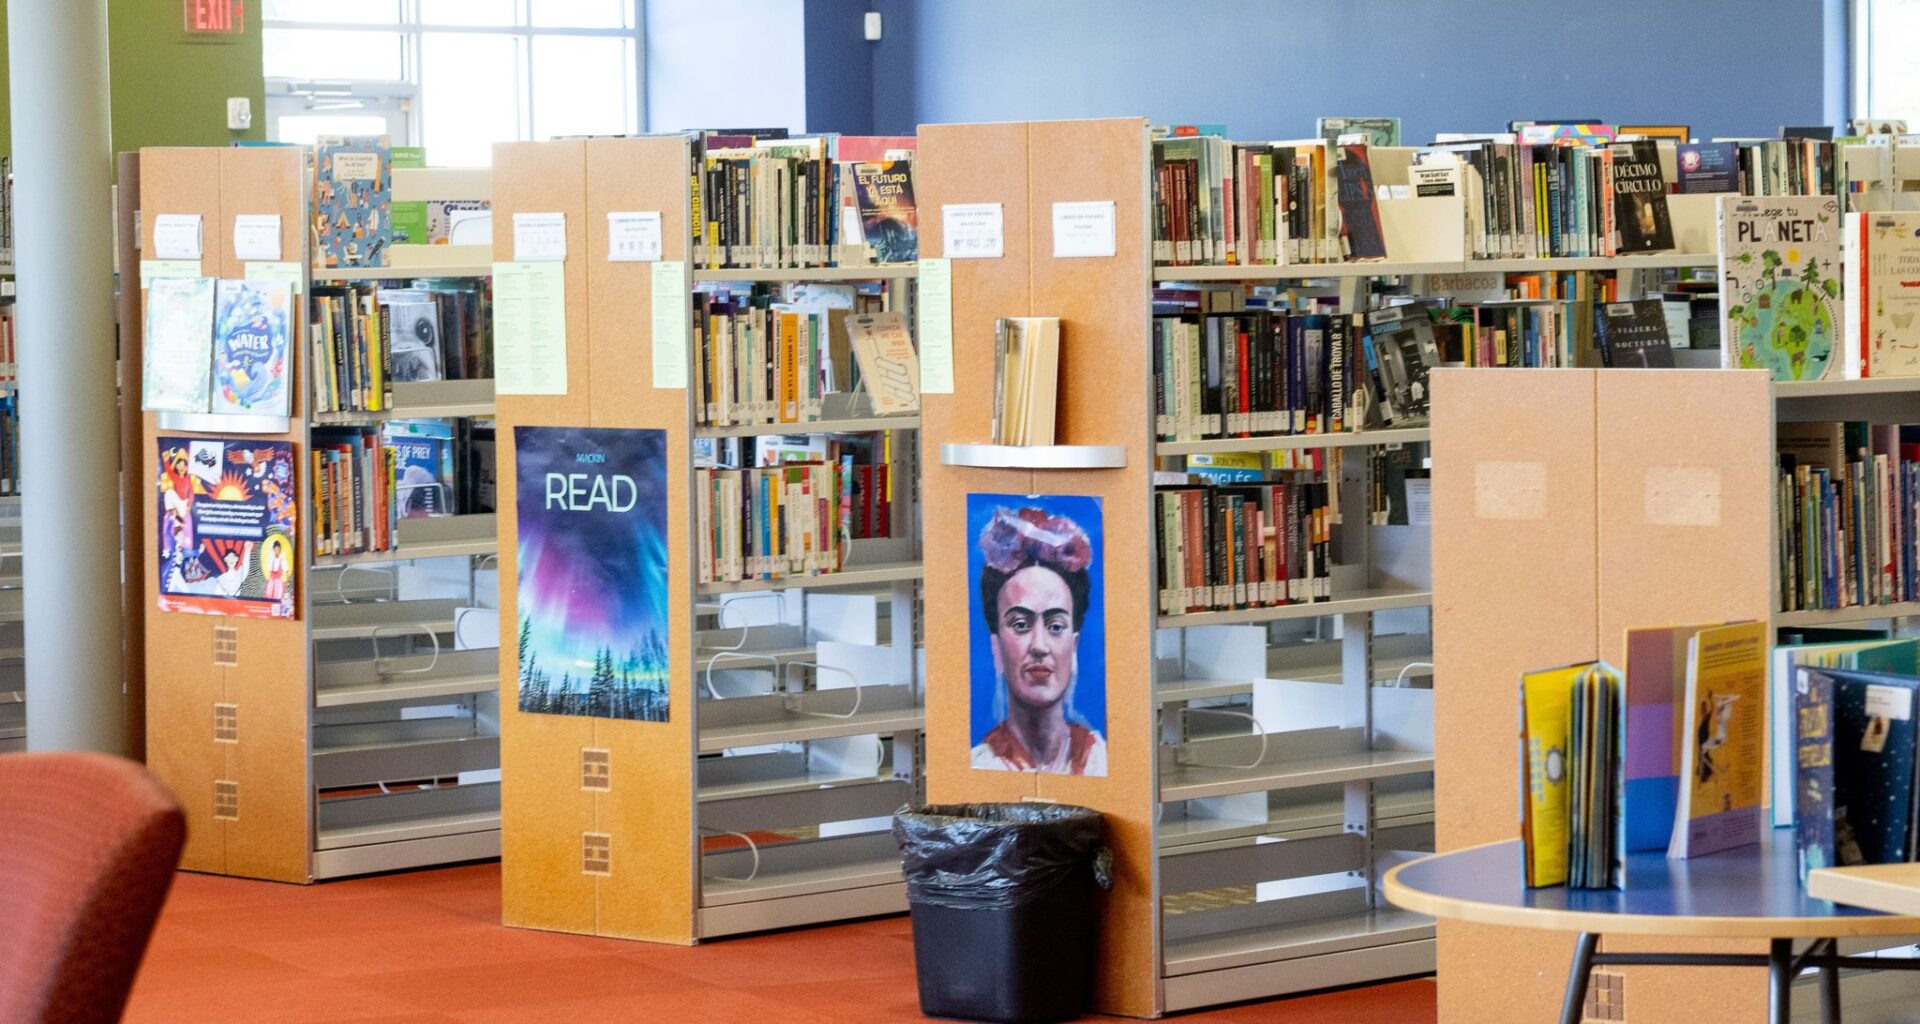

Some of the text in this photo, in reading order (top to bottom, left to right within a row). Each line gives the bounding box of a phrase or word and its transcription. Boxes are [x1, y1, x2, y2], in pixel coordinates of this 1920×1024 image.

[196, 0, 232, 30] EXIT
[871, 173, 907, 184] FUTURO
[1614, 162, 1657, 178] DÉCIMO
[1615, 178, 1662, 194] CÍRCULO
[1787, 206, 1799, 217] tu
[1738, 219, 1829, 242] PLANETA
[1431, 275, 1497, 291] Barbacoa
[228, 333, 269, 351] WATER
[1331, 341, 1342, 369] TROYA
[1332, 381, 1343, 419] CABALLO
[546, 473, 638, 513] READ
